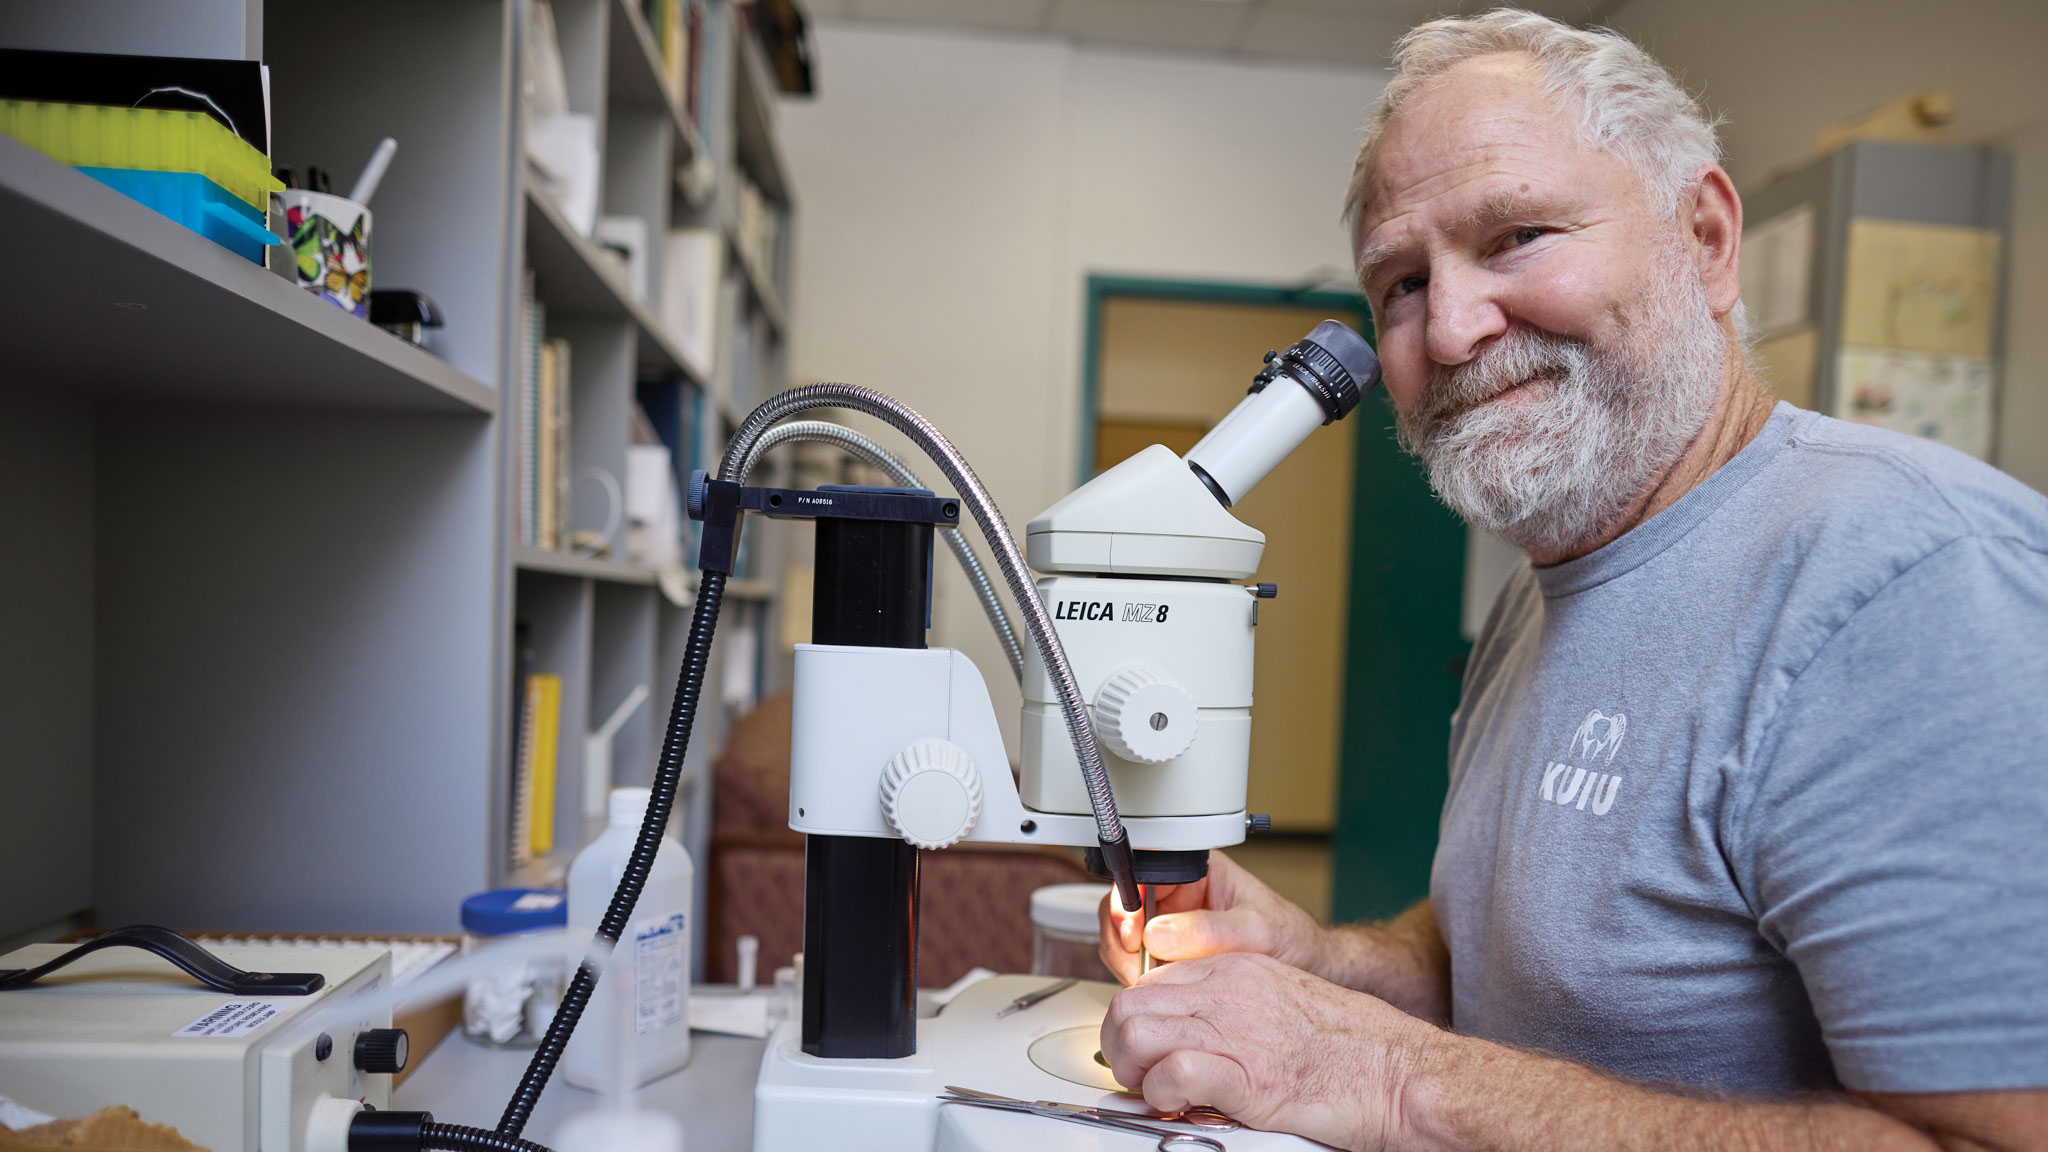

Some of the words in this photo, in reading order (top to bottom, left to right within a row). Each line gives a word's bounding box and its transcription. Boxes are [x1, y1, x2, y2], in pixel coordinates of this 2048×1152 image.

[1292, 362, 1309, 376] LEICA
[798, 496, 810, 504] P/N
[1055, 601, 1114, 621] LEICA
[1538, 760, 1622, 816] KUIU
[183, 1004, 242, 1033] WARNING
[219, 1019, 246, 1034] BEFORE
[239, 1004, 273, 1021] REMOVING
